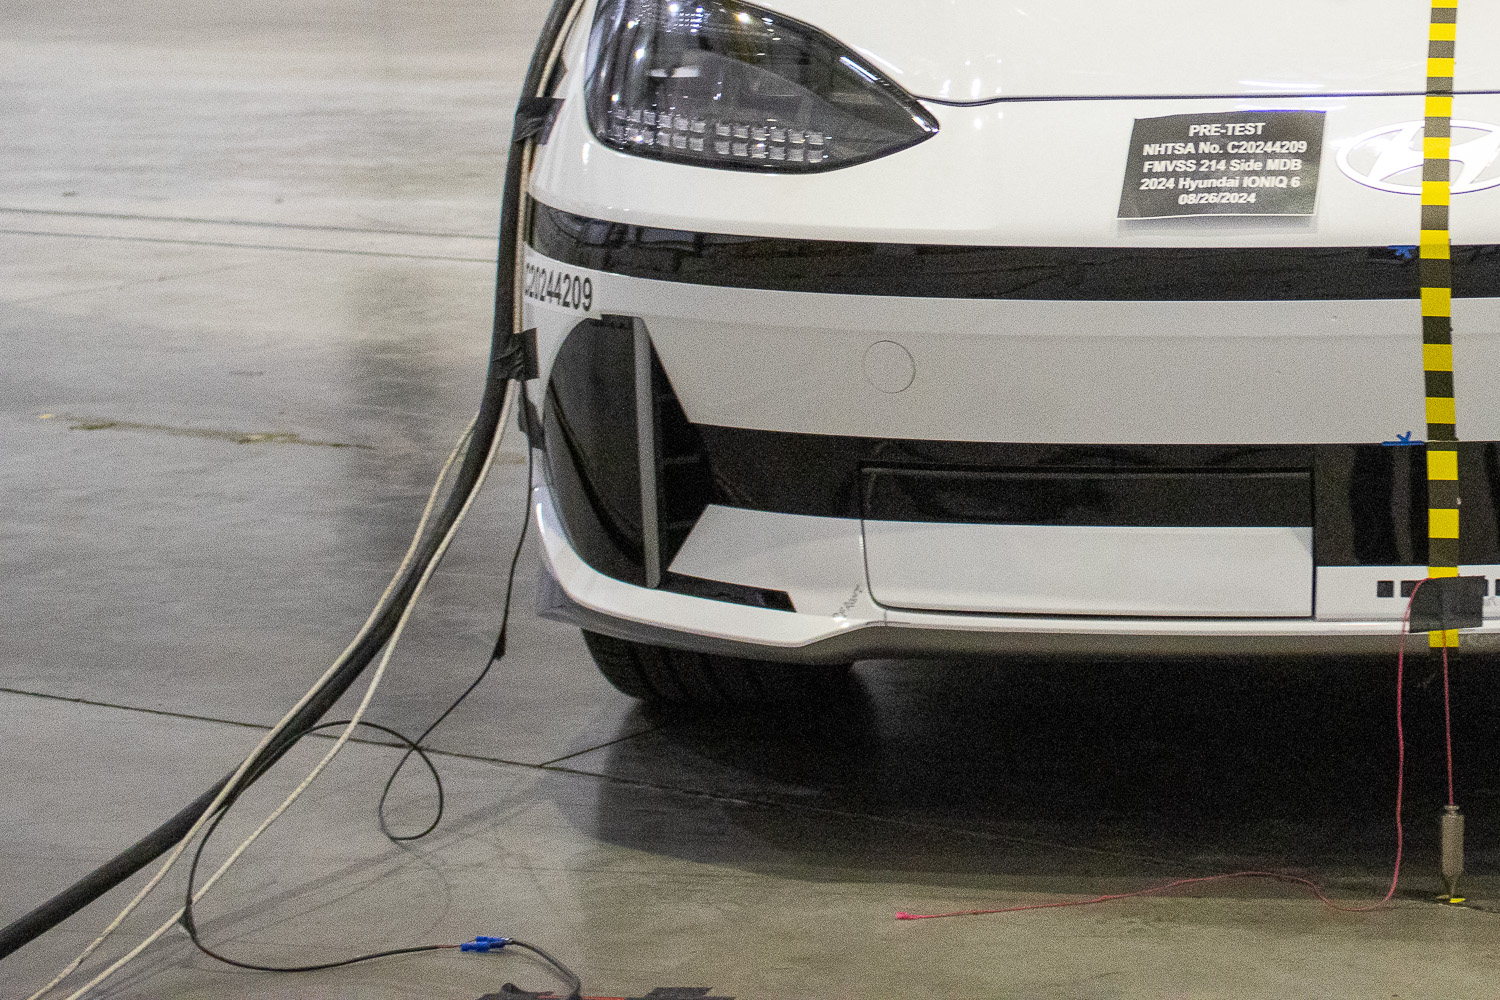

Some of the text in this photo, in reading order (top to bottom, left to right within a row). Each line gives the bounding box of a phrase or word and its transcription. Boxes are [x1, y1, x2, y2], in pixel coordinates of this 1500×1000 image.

[1188, 122, 1266, 137] PRE-TEST
[1142, 141, 1307, 156] NHTSA No. C20244209
[1142, 158, 1302, 173] FMVSS 214 Side MDB
[1139, 176, 1301, 191] 2024 Hyundai IONIQ 6
[1178, 193, 1257, 205] 08/26/2024
